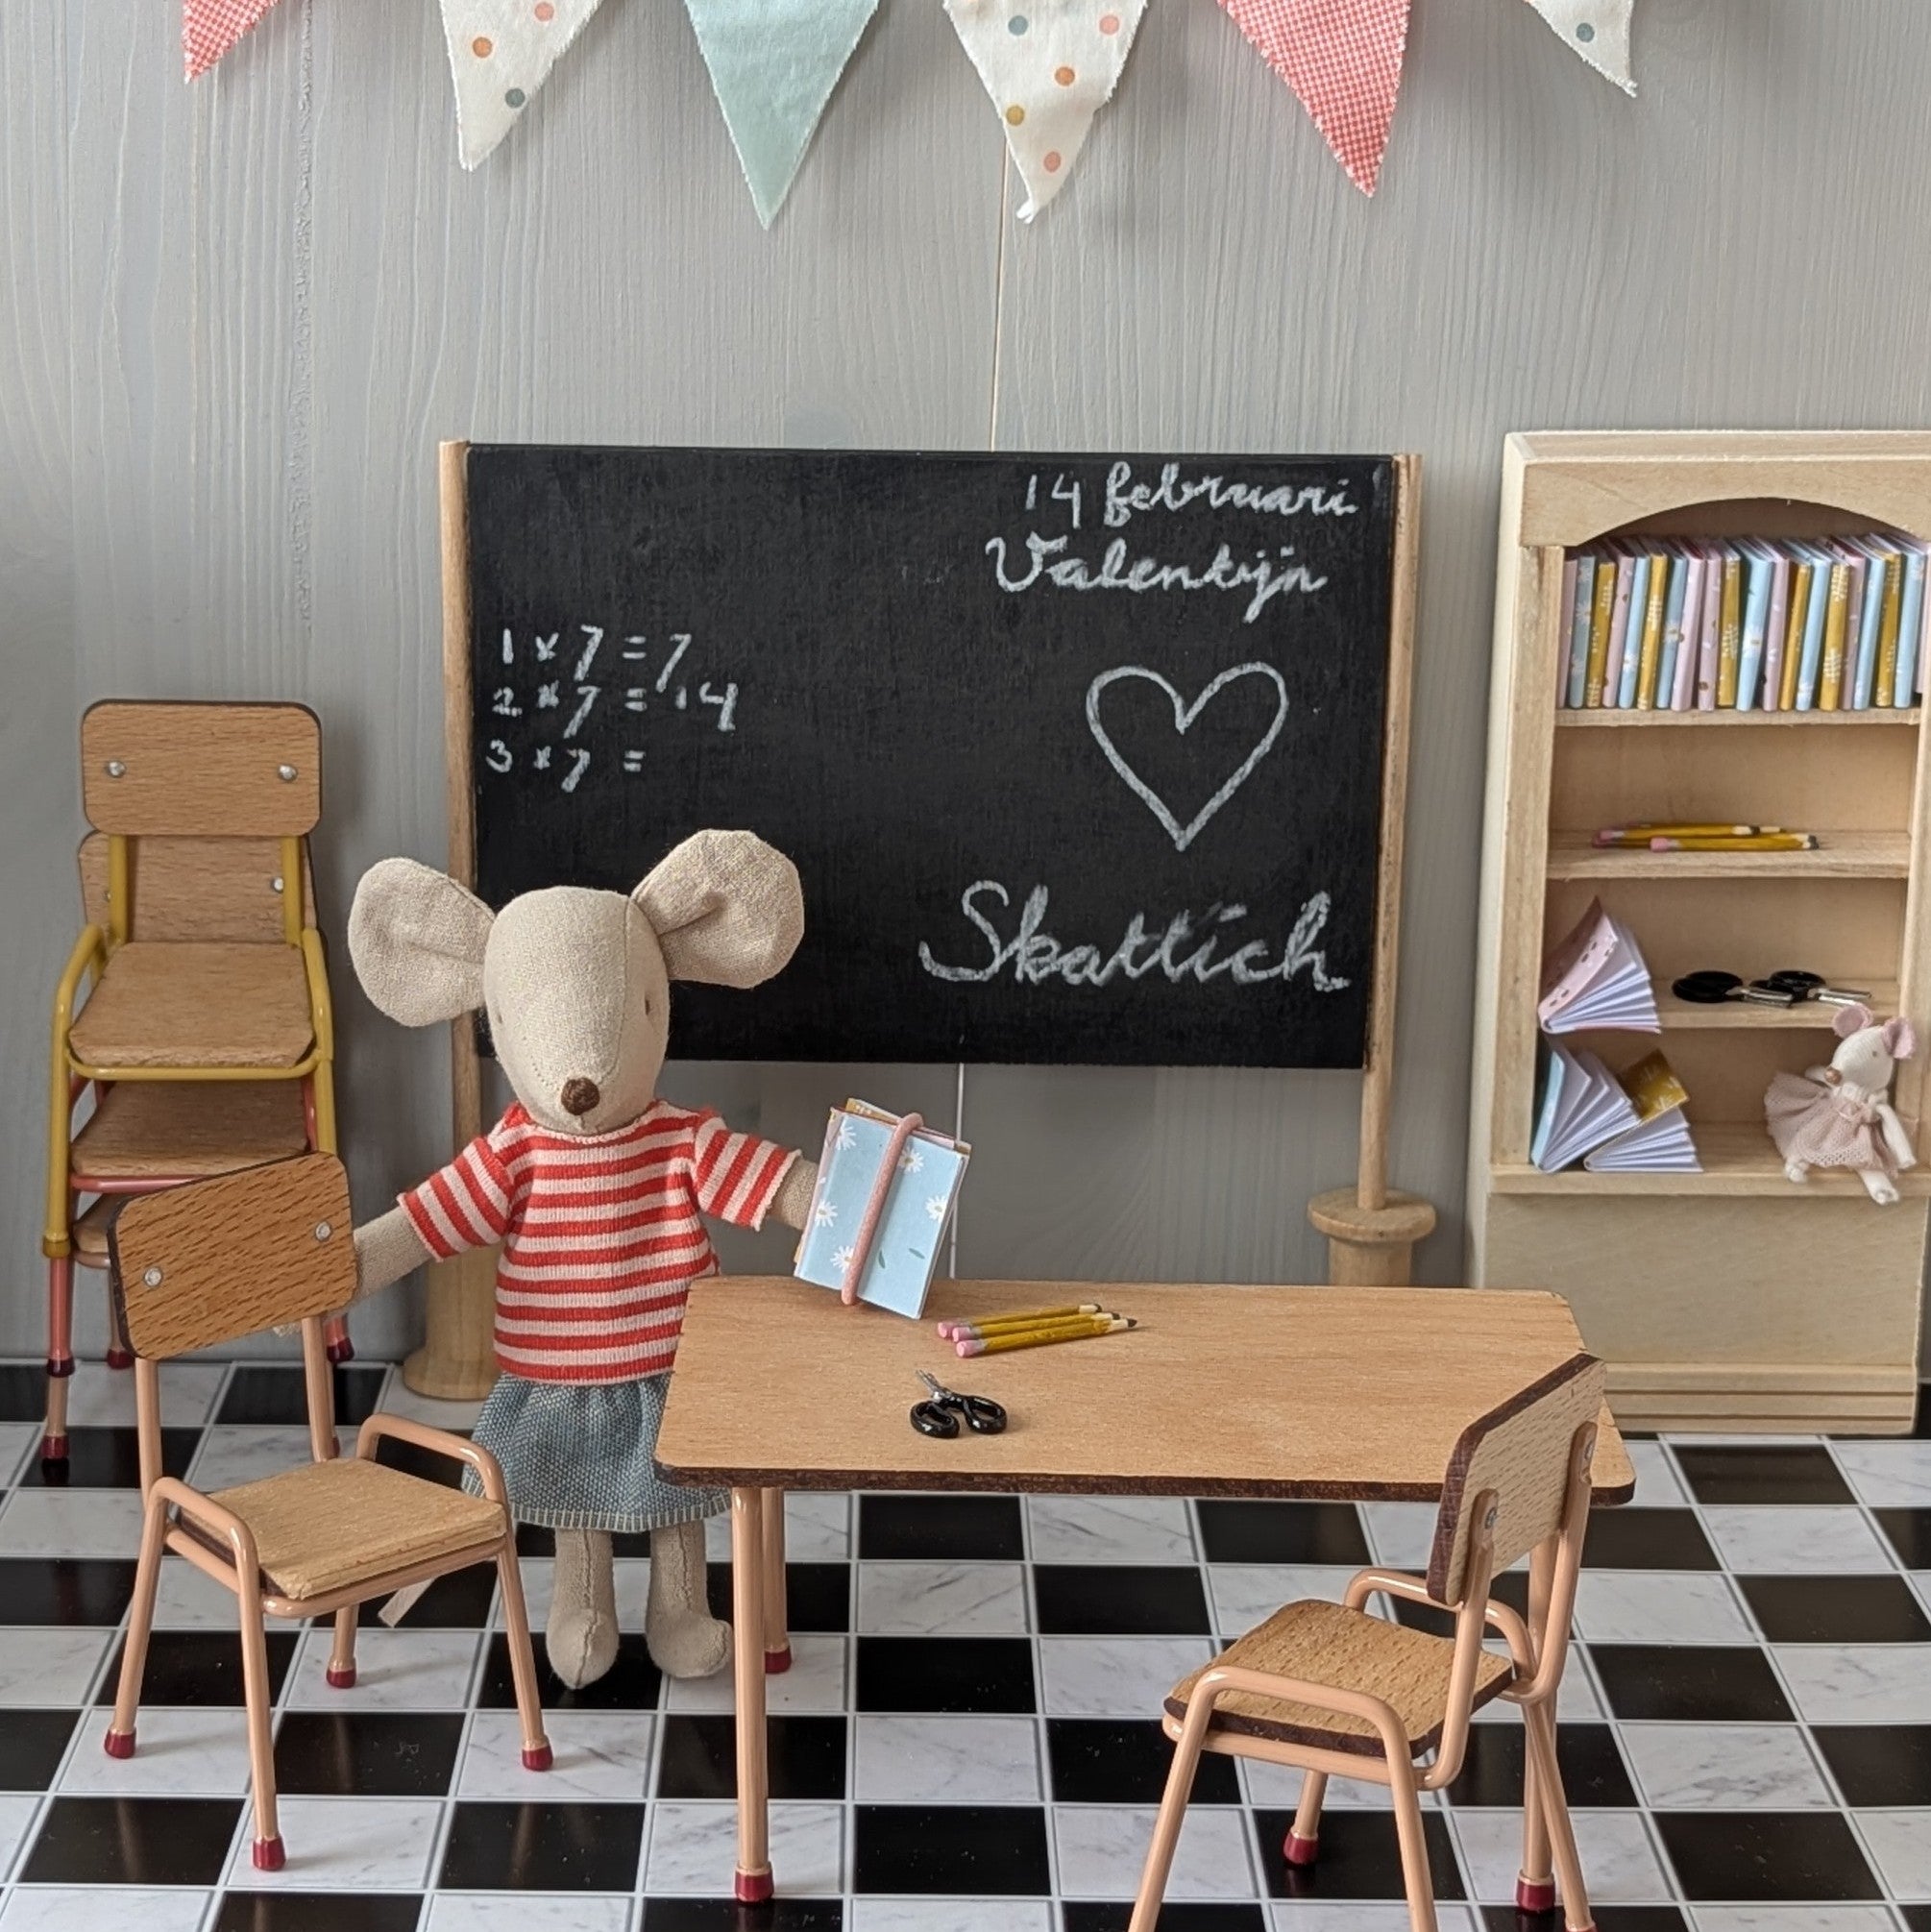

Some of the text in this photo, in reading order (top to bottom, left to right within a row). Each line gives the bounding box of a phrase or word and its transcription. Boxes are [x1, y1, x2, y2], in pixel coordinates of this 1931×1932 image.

[1025, 461, 1358, 528] 14 februari
[985, 530, 1329, 624] Valentijn
[501, 627, 514, 664] 1
[574, 624, 603, 681] 7
[655, 633, 692, 693] 7
[492, 686, 523, 717] 2
[564, 685, 601, 739] 7
[675, 681, 739, 732] 14
[486, 739, 513, 772] 3
[561, 747, 591, 793] 7
